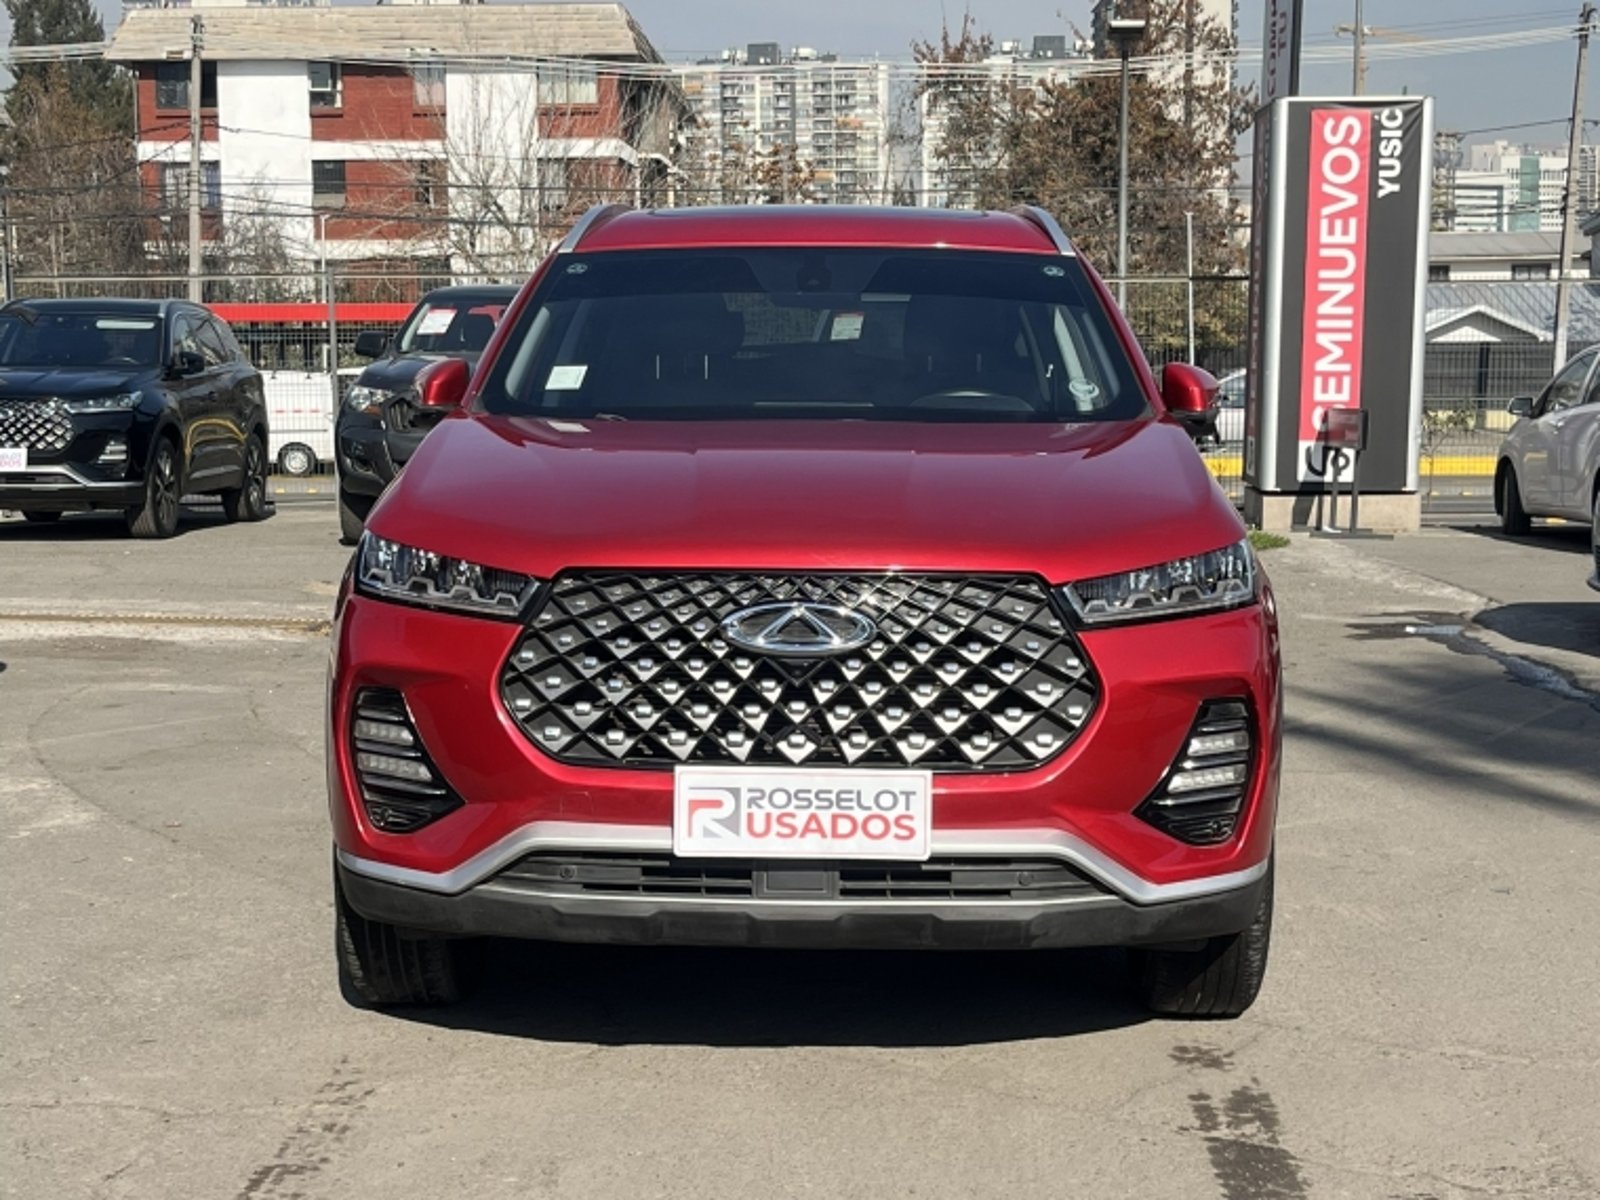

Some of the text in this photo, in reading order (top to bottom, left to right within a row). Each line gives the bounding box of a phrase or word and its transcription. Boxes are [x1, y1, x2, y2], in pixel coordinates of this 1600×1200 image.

[1374, 108, 1403, 199] YUSIĆ
[746, 788, 917, 812] ROSSELOT
[746, 812, 917, 840] USADOS
